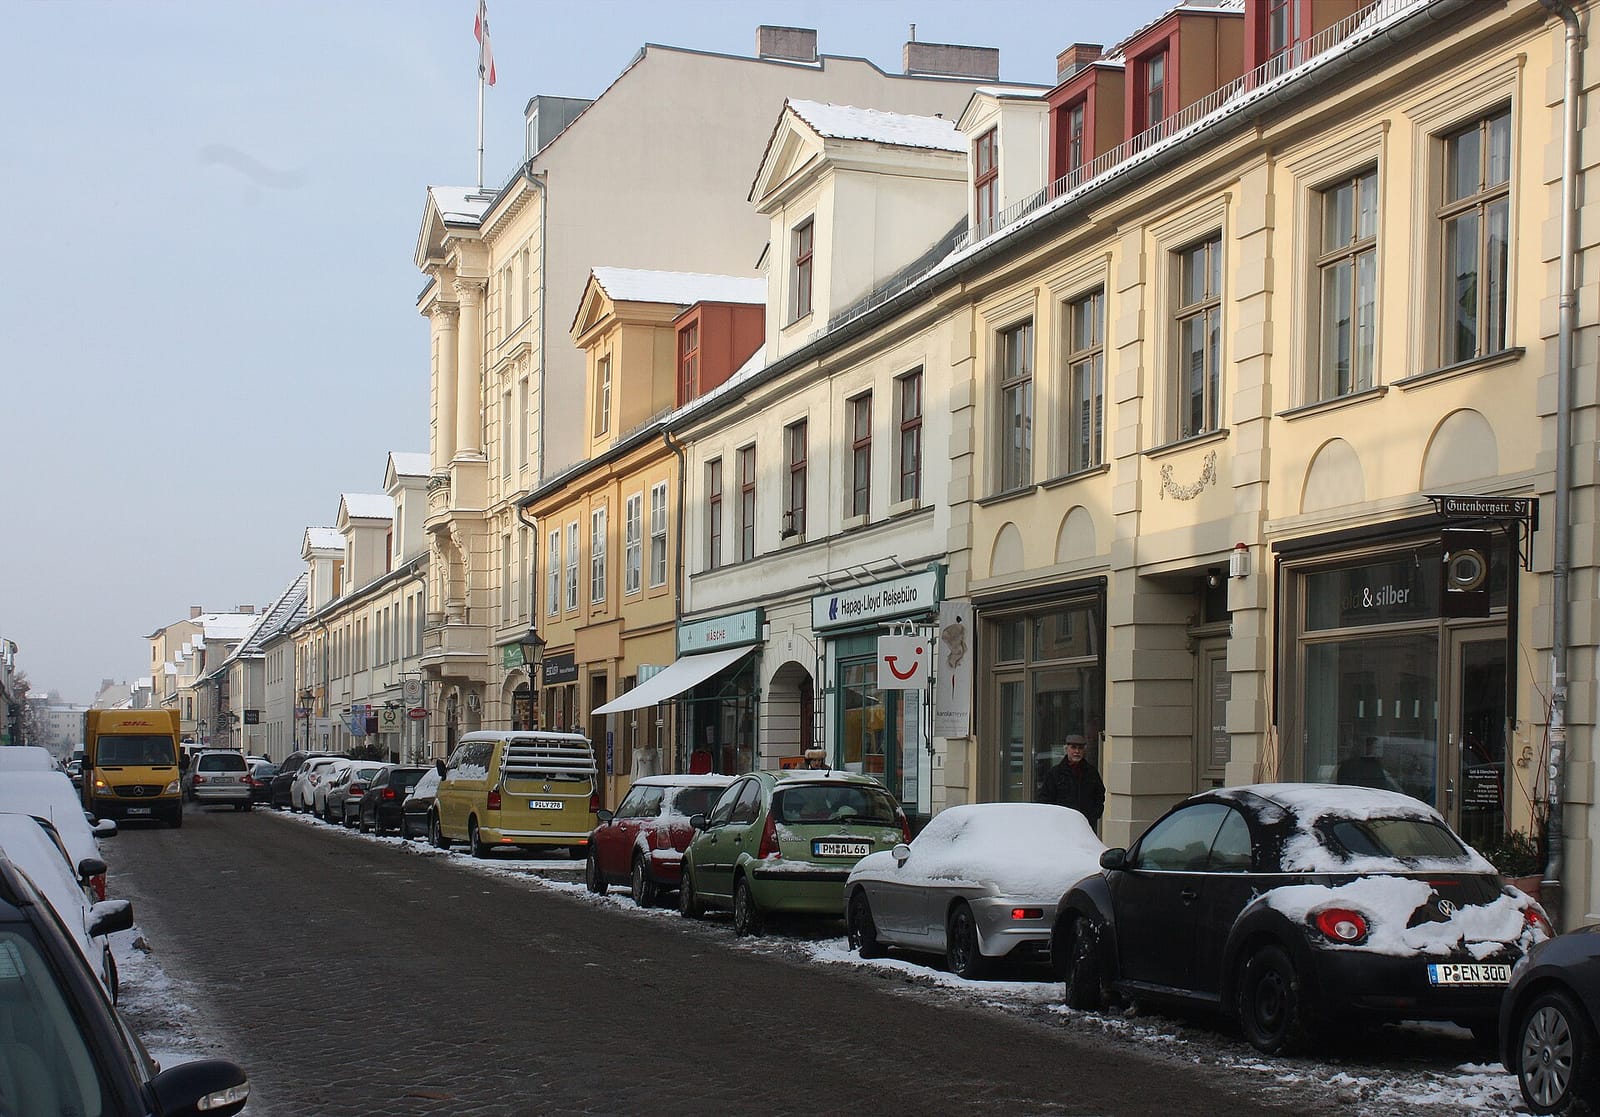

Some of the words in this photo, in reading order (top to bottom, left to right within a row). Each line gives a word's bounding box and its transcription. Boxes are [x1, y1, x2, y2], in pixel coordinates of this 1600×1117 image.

[1446, 499, 1512, 515] Gutenbergstr.
[1514, 501, 1526, 513] 87
[841, 594, 881, 617] Hapag-Lloyd
[882, 585, 917, 608] Reisebüro
[1362, 587, 1373, 608] &
[1375, 584, 1410, 606] silber
[823, 844, 836, 854] PM
[841, 844, 853, 854] AL
[854, 845, 866, 854] 66
[1443, 966, 1452, 981] P
[1461, 966, 1480, 981] EN
[1482, 966, 1506, 981] 300
